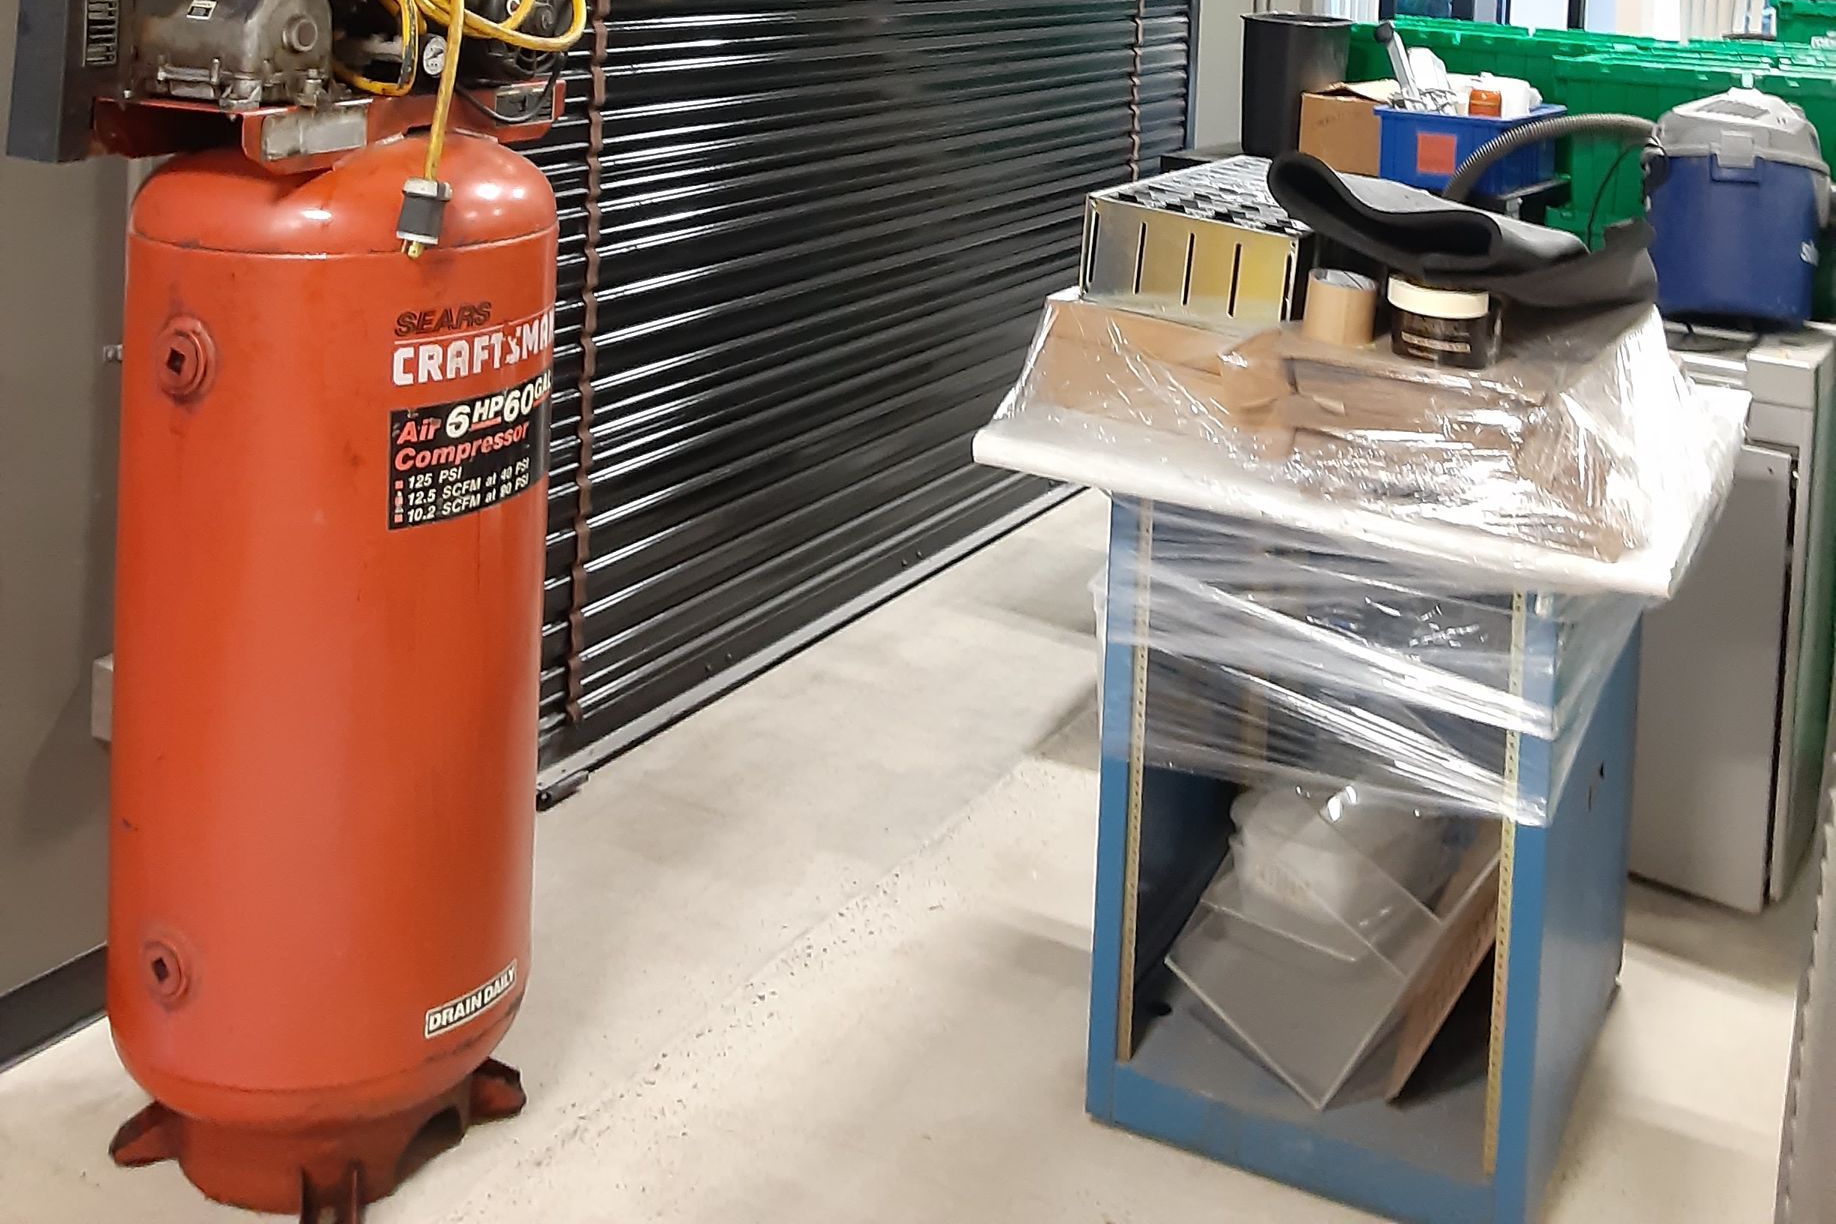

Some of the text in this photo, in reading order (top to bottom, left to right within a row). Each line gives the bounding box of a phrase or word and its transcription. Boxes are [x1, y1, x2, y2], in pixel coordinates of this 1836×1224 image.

[395, 302, 491, 337] SEARS
[394, 421, 530, 471] Compressor
[397, 417, 442, 444] Air
[407, 505, 436, 523] 10.2
[442, 493, 481, 516] SCFM
[485, 488, 496, 503] at
[514, 473, 529, 491] PSI
[408, 466, 462, 490] 125 PSI
[408, 457, 530, 506] 12.5 SCFM at 40 PSI
[429, 966, 515, 1031] DRAIN DAILY
